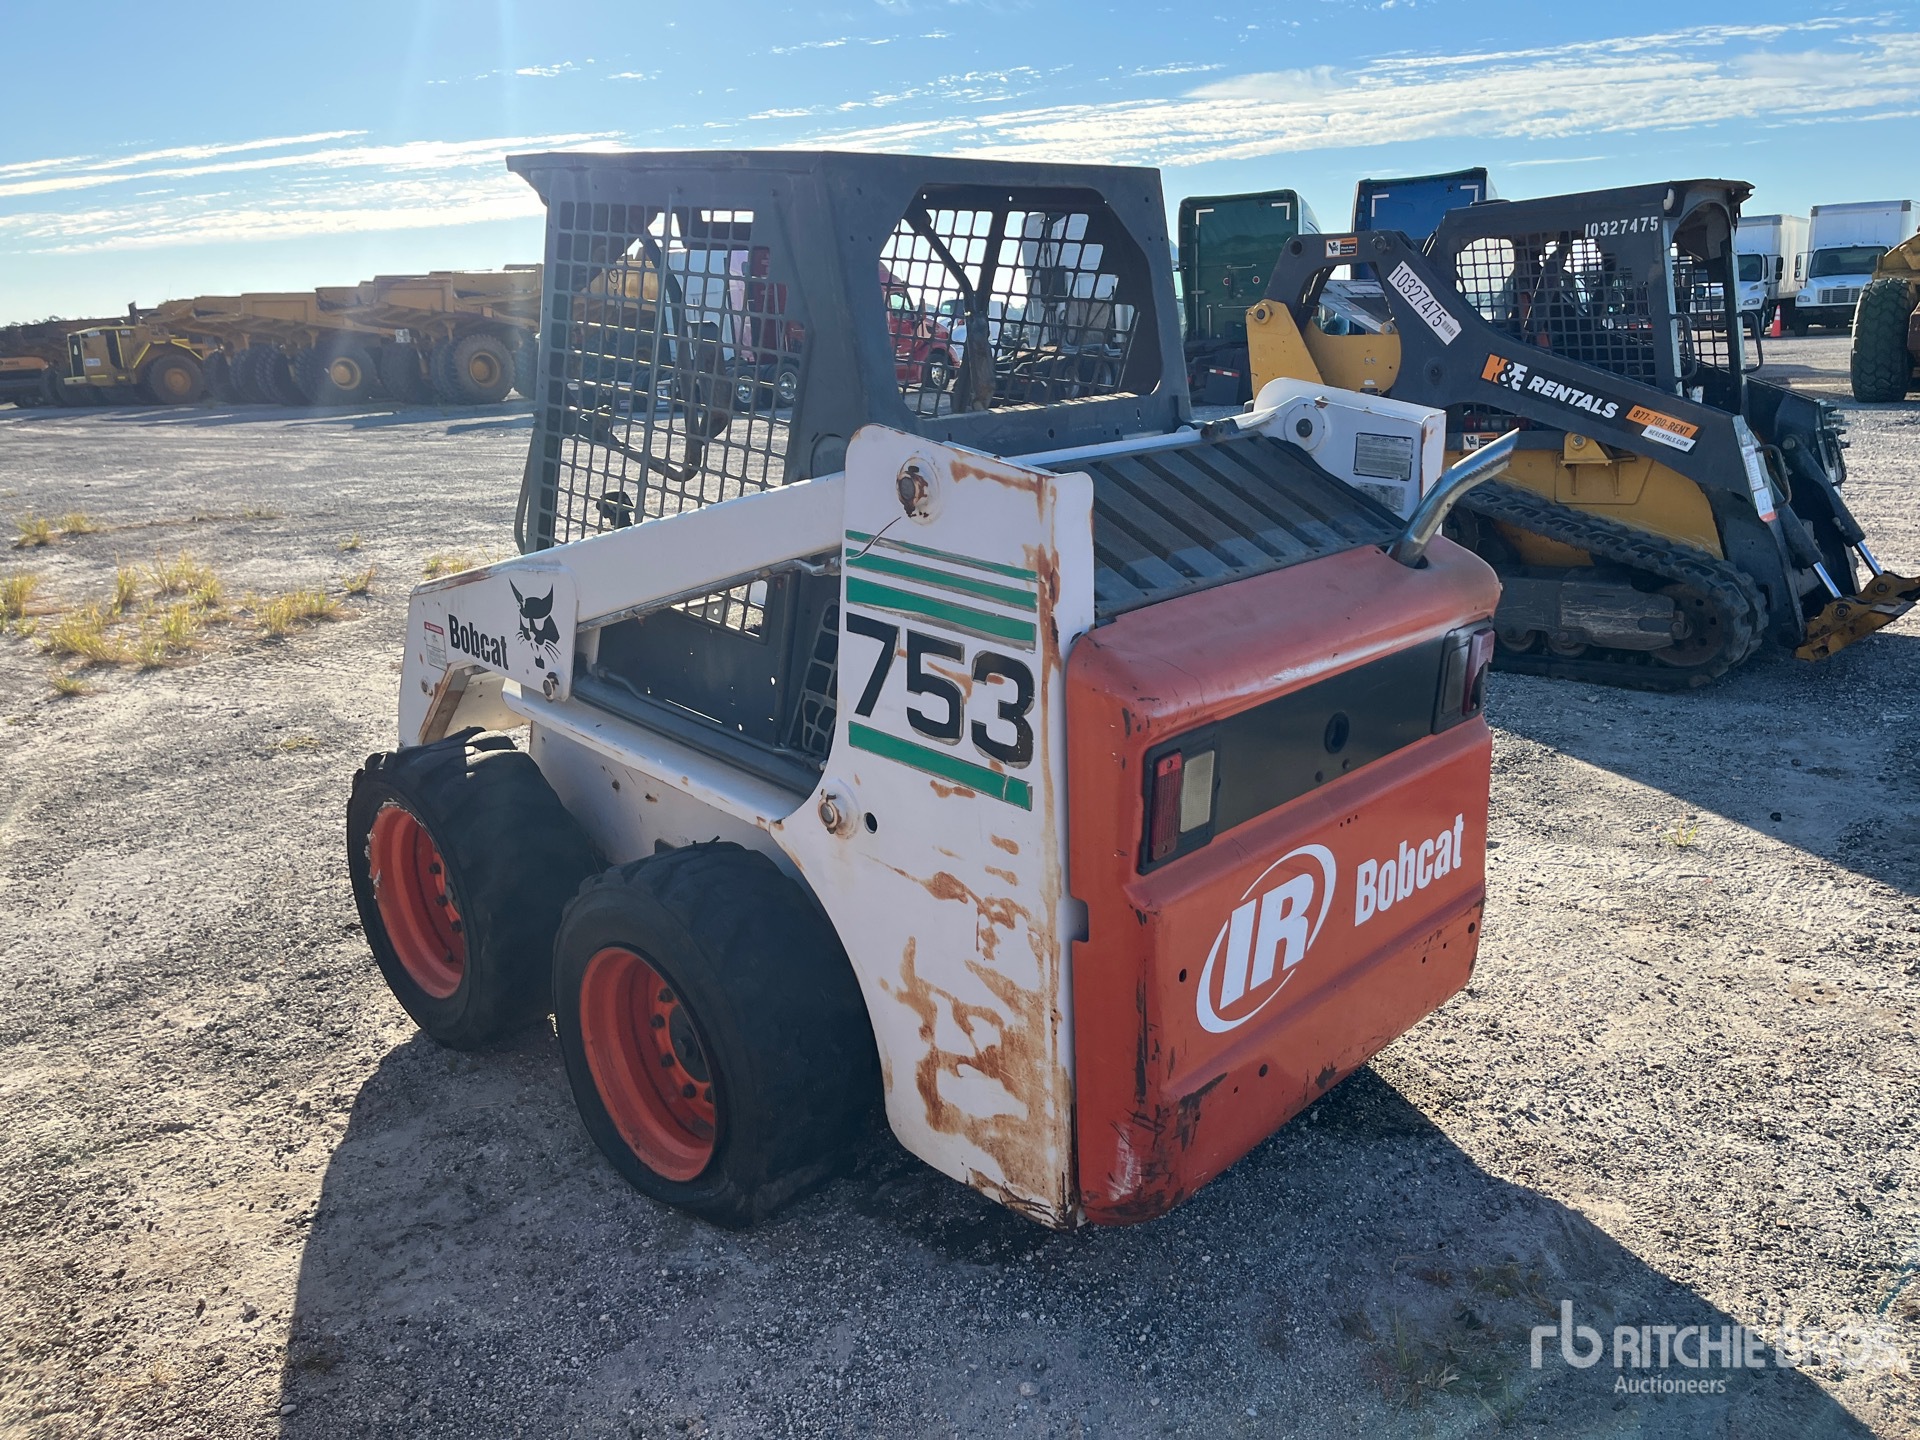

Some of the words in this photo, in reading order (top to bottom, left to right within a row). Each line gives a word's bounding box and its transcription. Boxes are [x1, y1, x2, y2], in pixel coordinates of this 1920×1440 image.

[1584, 216, 1659, 238] 10327475
[1391, 265, 1447, 328] 10327475
[1482, 354, 1528, 392] H&E
[1527, 375, 1619, 419] RENTALS
[1633, 409, 1691, 435] 877-700-RENT
[1648, 429, 1689, 447] HERENTALS.COM
[448, 613, 509, 671] Bobcat
[846, 612, 1035, 769] 753
[1219, 873, 1314, 1010] IR
[1355, 813, 1464, 927] Bobcat
